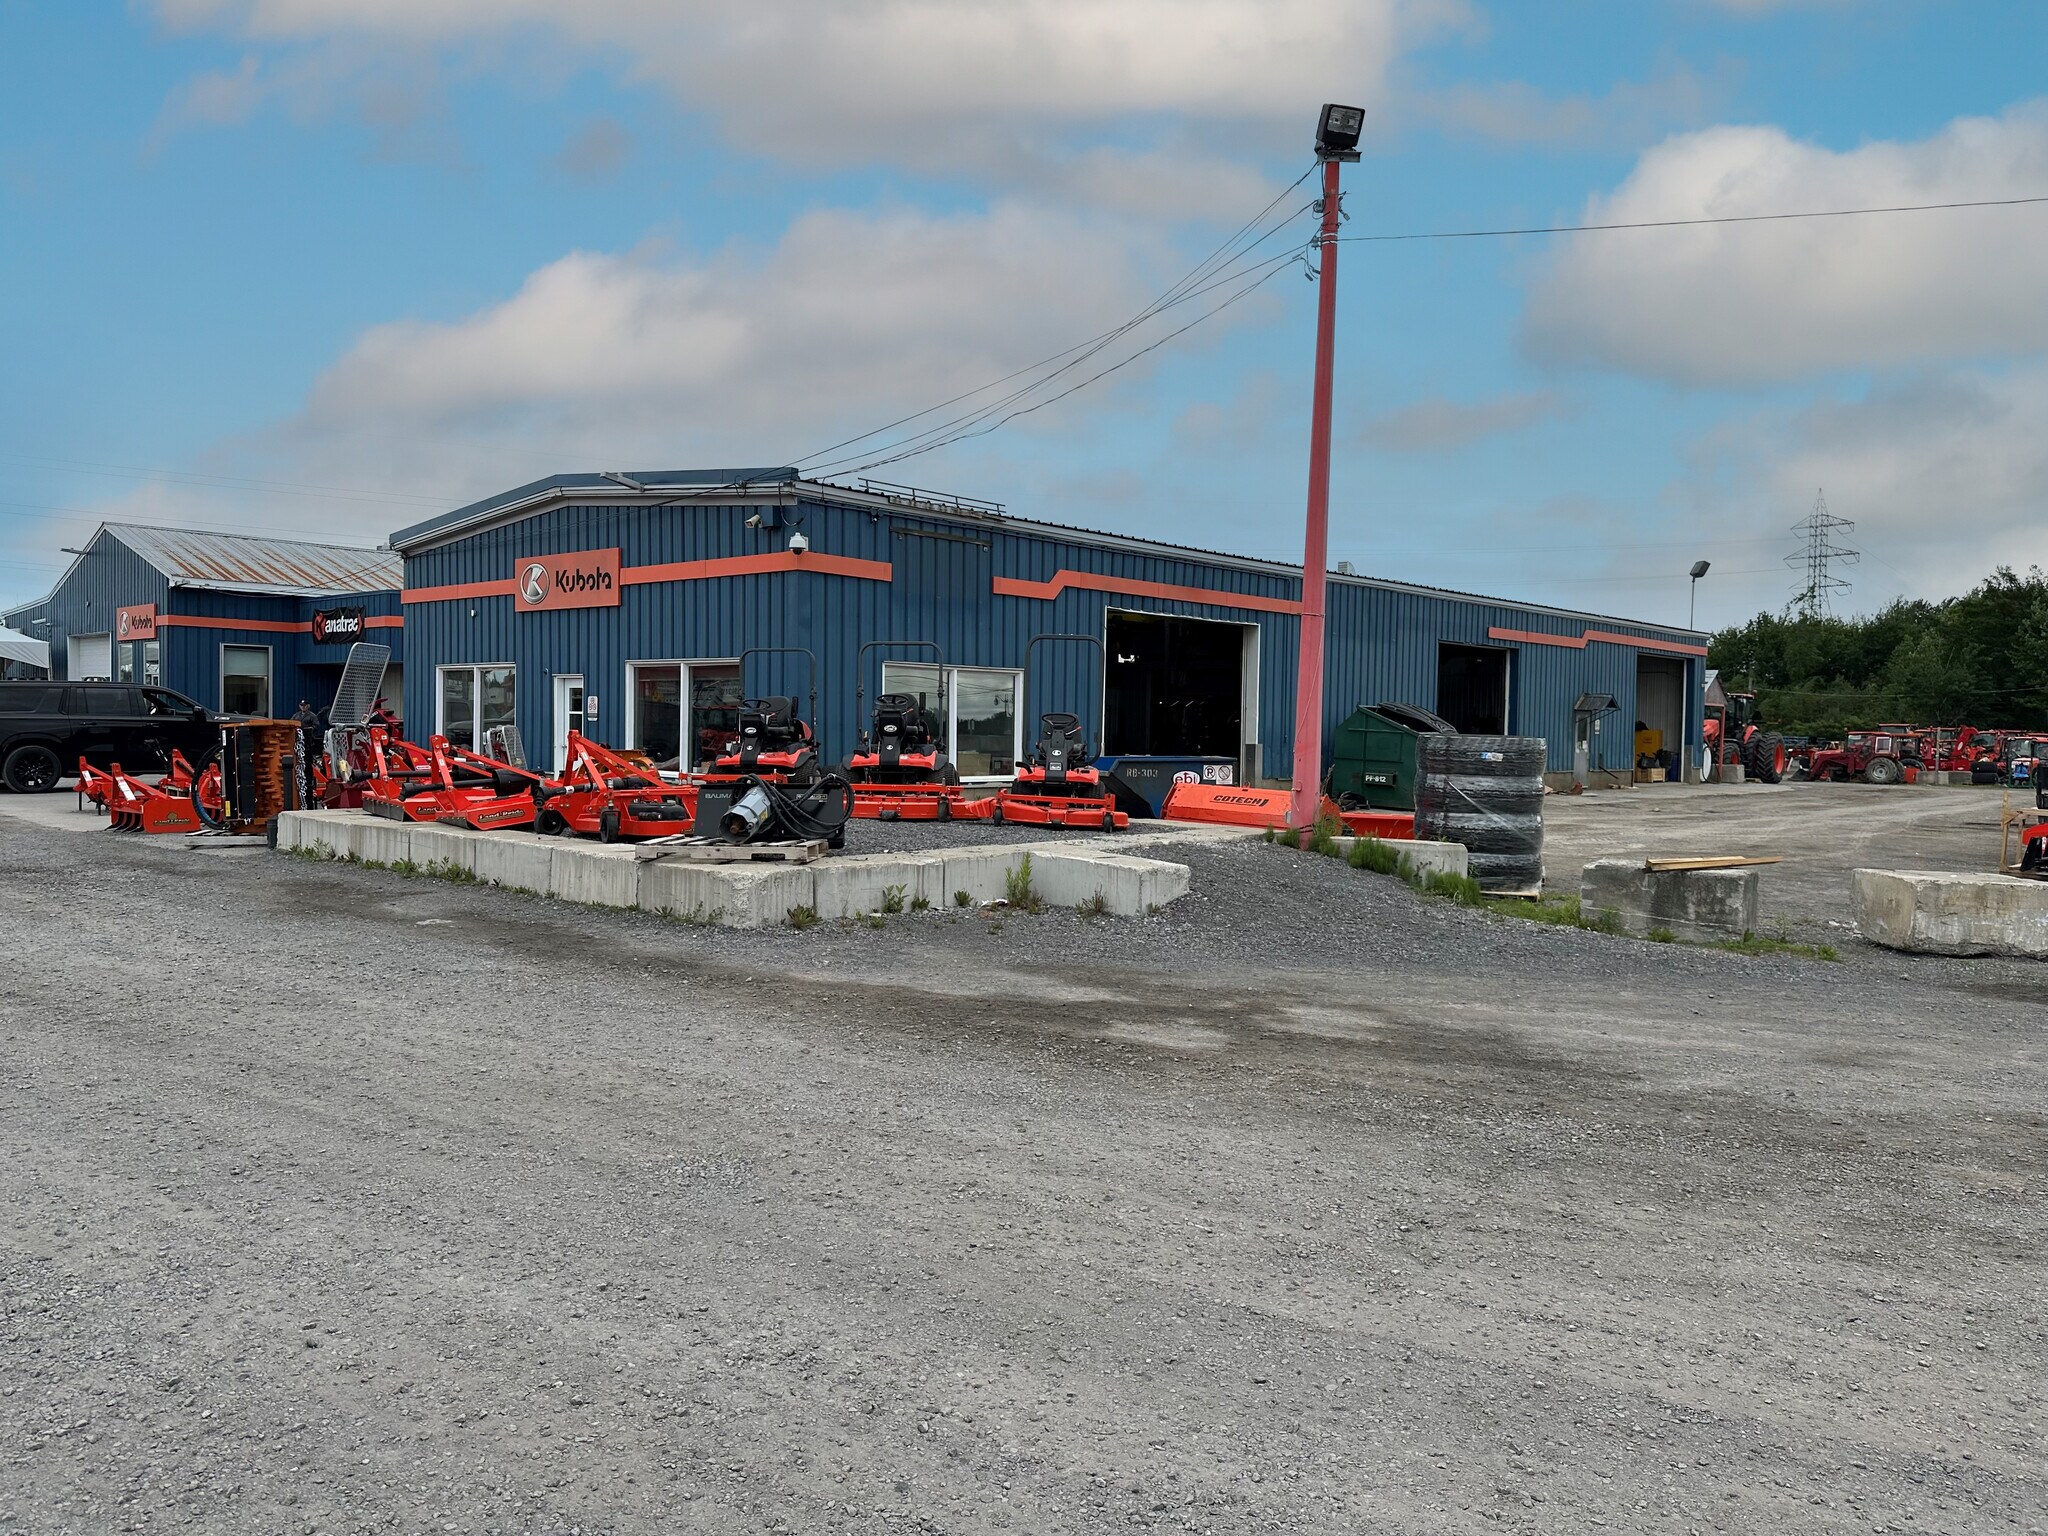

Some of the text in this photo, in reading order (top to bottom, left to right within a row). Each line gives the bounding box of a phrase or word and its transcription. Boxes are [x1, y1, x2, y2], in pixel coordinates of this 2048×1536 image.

[555, 566, 612, 593] Kubota
[131, 614, 153, 630] Kubota
[1126, 767, 1158, 778] RB-303
[1213, 794, 1263, 805] COTECH
